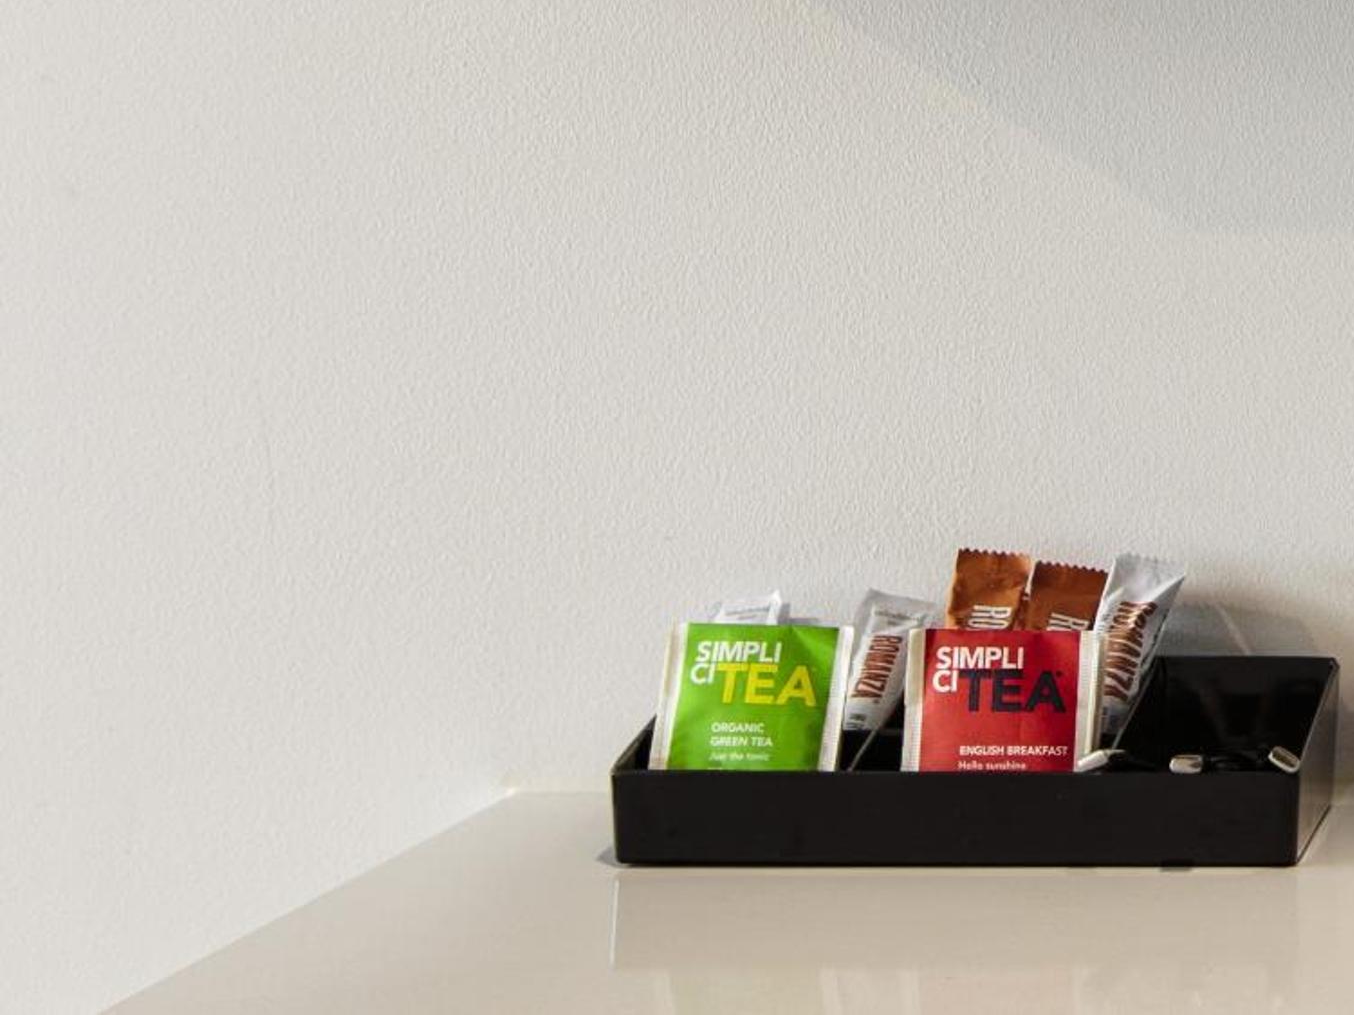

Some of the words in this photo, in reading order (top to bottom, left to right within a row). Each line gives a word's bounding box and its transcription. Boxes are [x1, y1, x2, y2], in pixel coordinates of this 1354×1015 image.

[695, 640, 783, 664] SIMPLI
[936, 646, 1024, 670] SIMPLI
[711, 721, 765, 734] ORGANIC
[710, 736, 748, 747] GREEN
[751, 736, 774, 748] TEA
[959, 745, 1005, 756] ENGLISH
[1006, 745, 1068, 757] BREAKFAST
[958, 760, 983, 771] Hello
[985, 760, 1027, 771] sunshine
